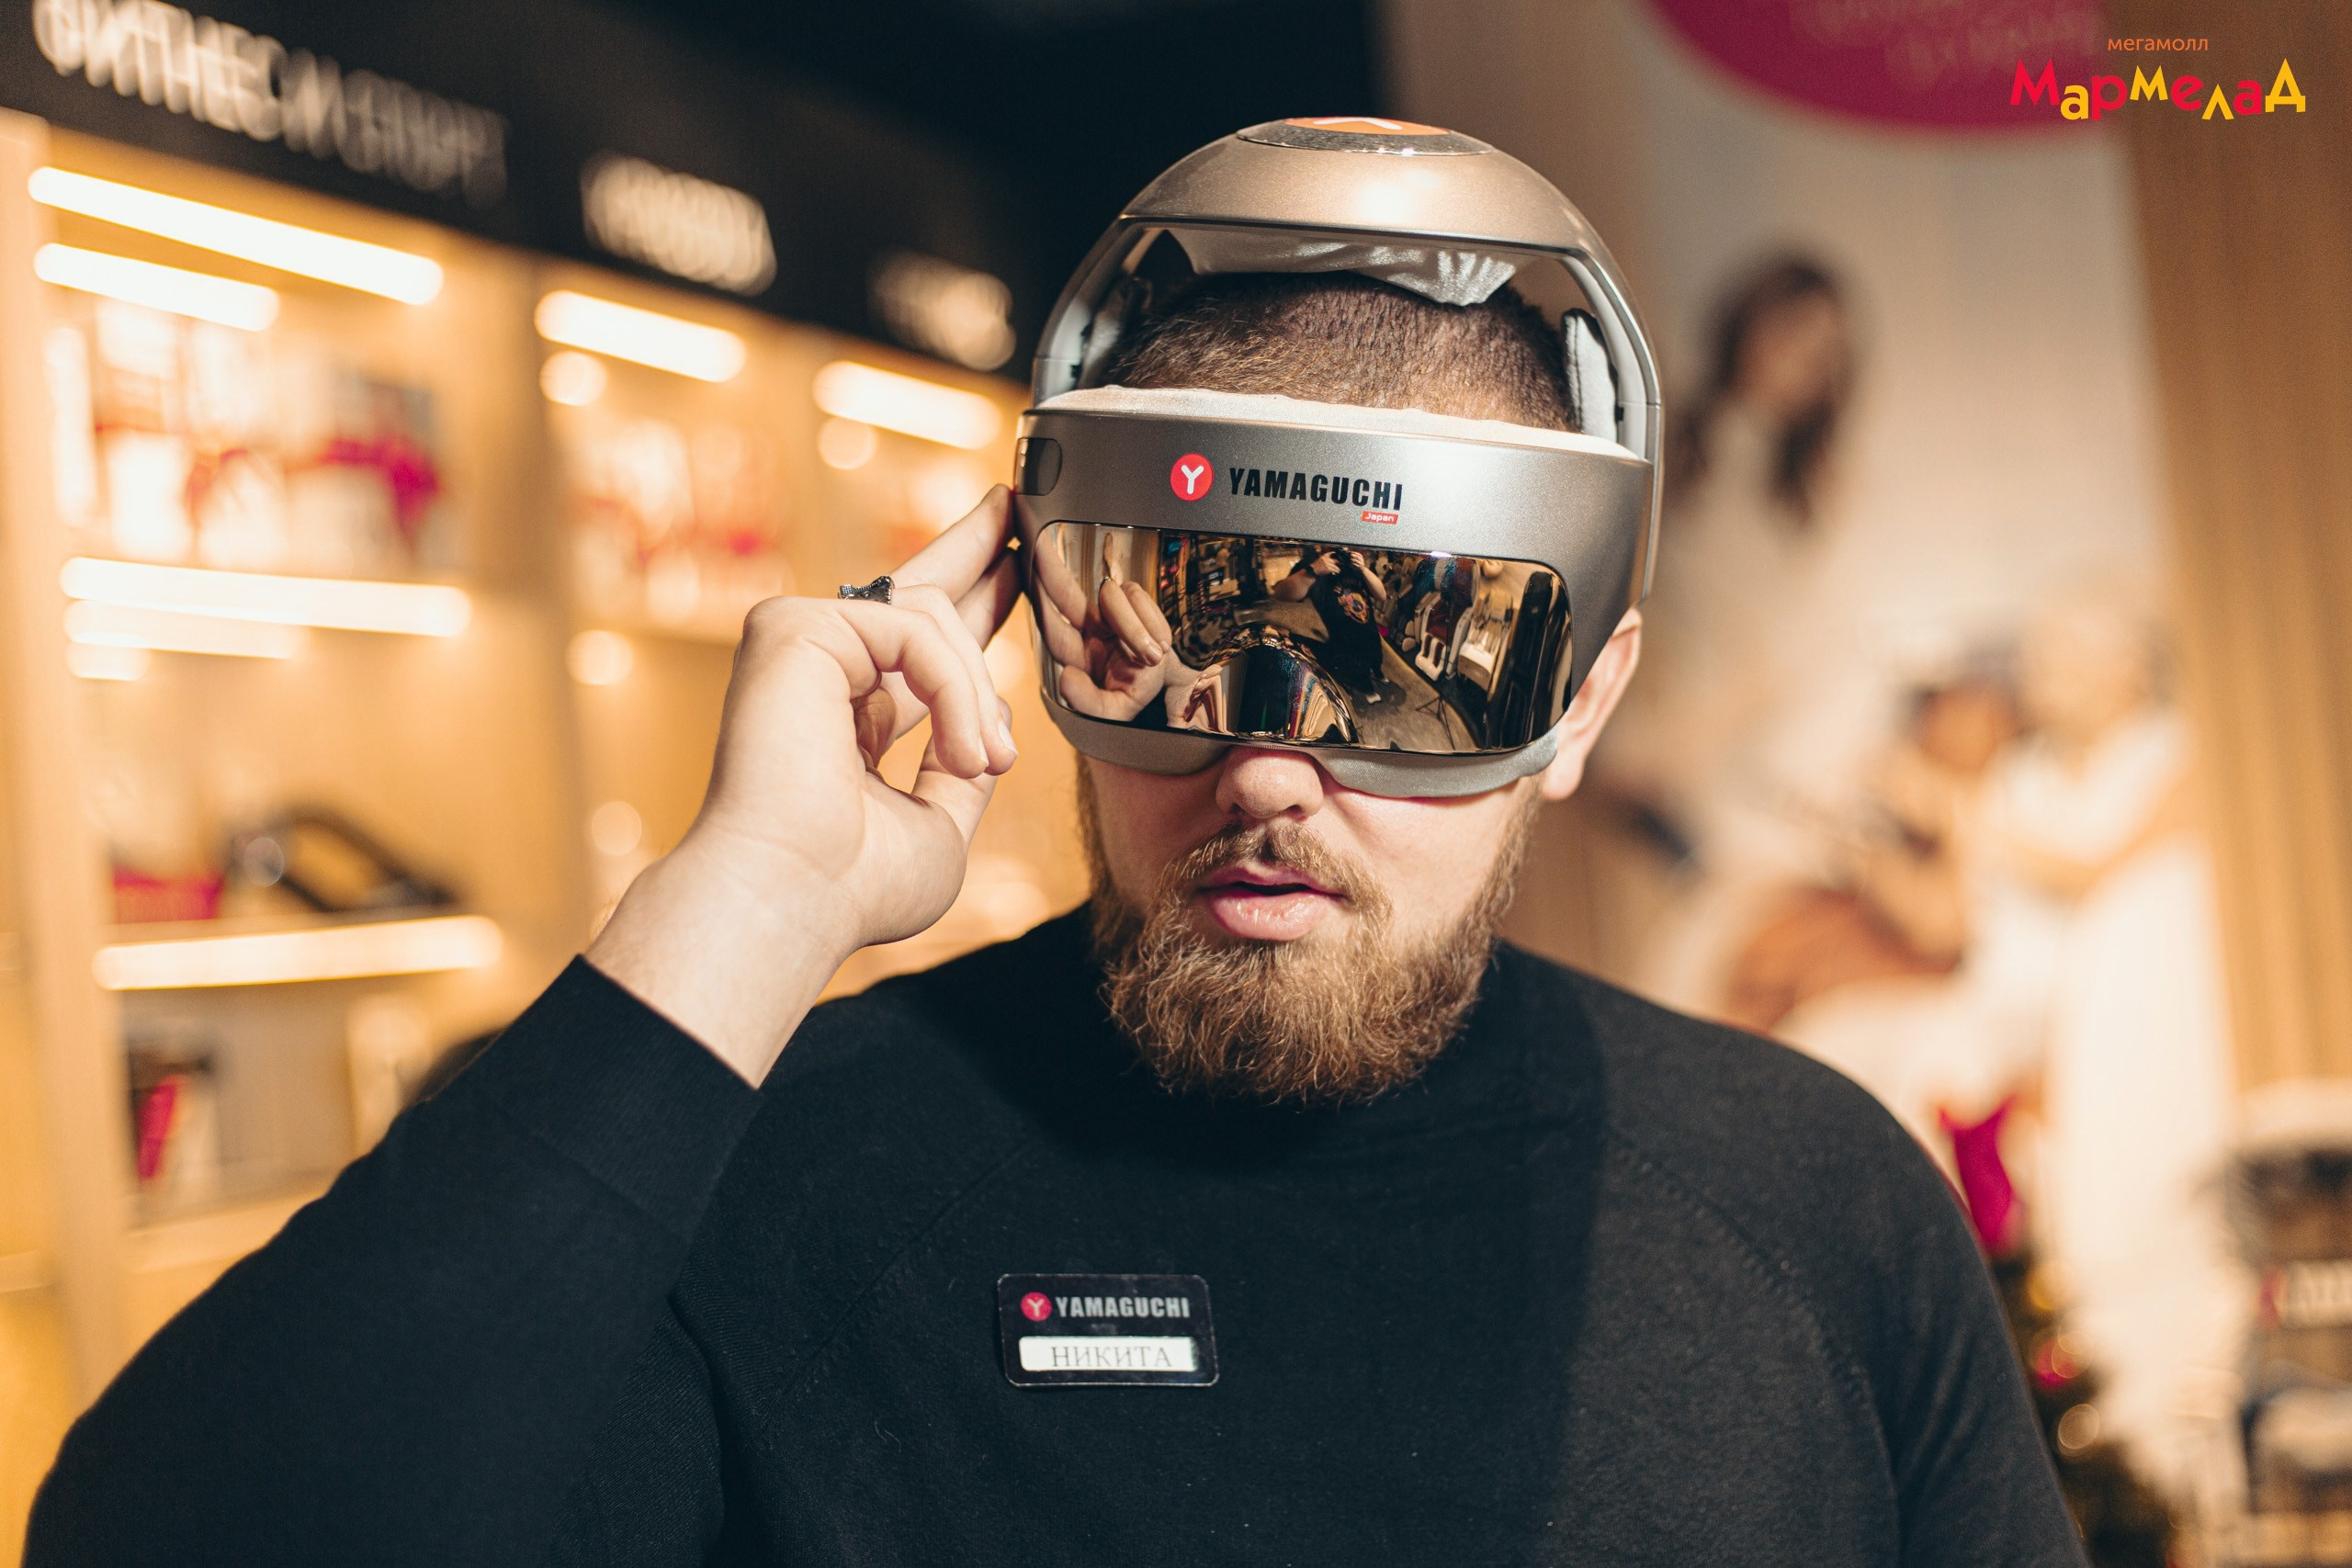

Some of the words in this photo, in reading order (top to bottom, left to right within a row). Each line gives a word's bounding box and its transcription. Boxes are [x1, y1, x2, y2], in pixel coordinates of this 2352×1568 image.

[1229, 468, 1403, 511] YAMAGUCHI
[1363, 511, 1396, 525] Japan
[1056, 1296, 1190, 1318] YAMAGUCHI
[1051, 1346, 1172, 1368] НИКИТА
